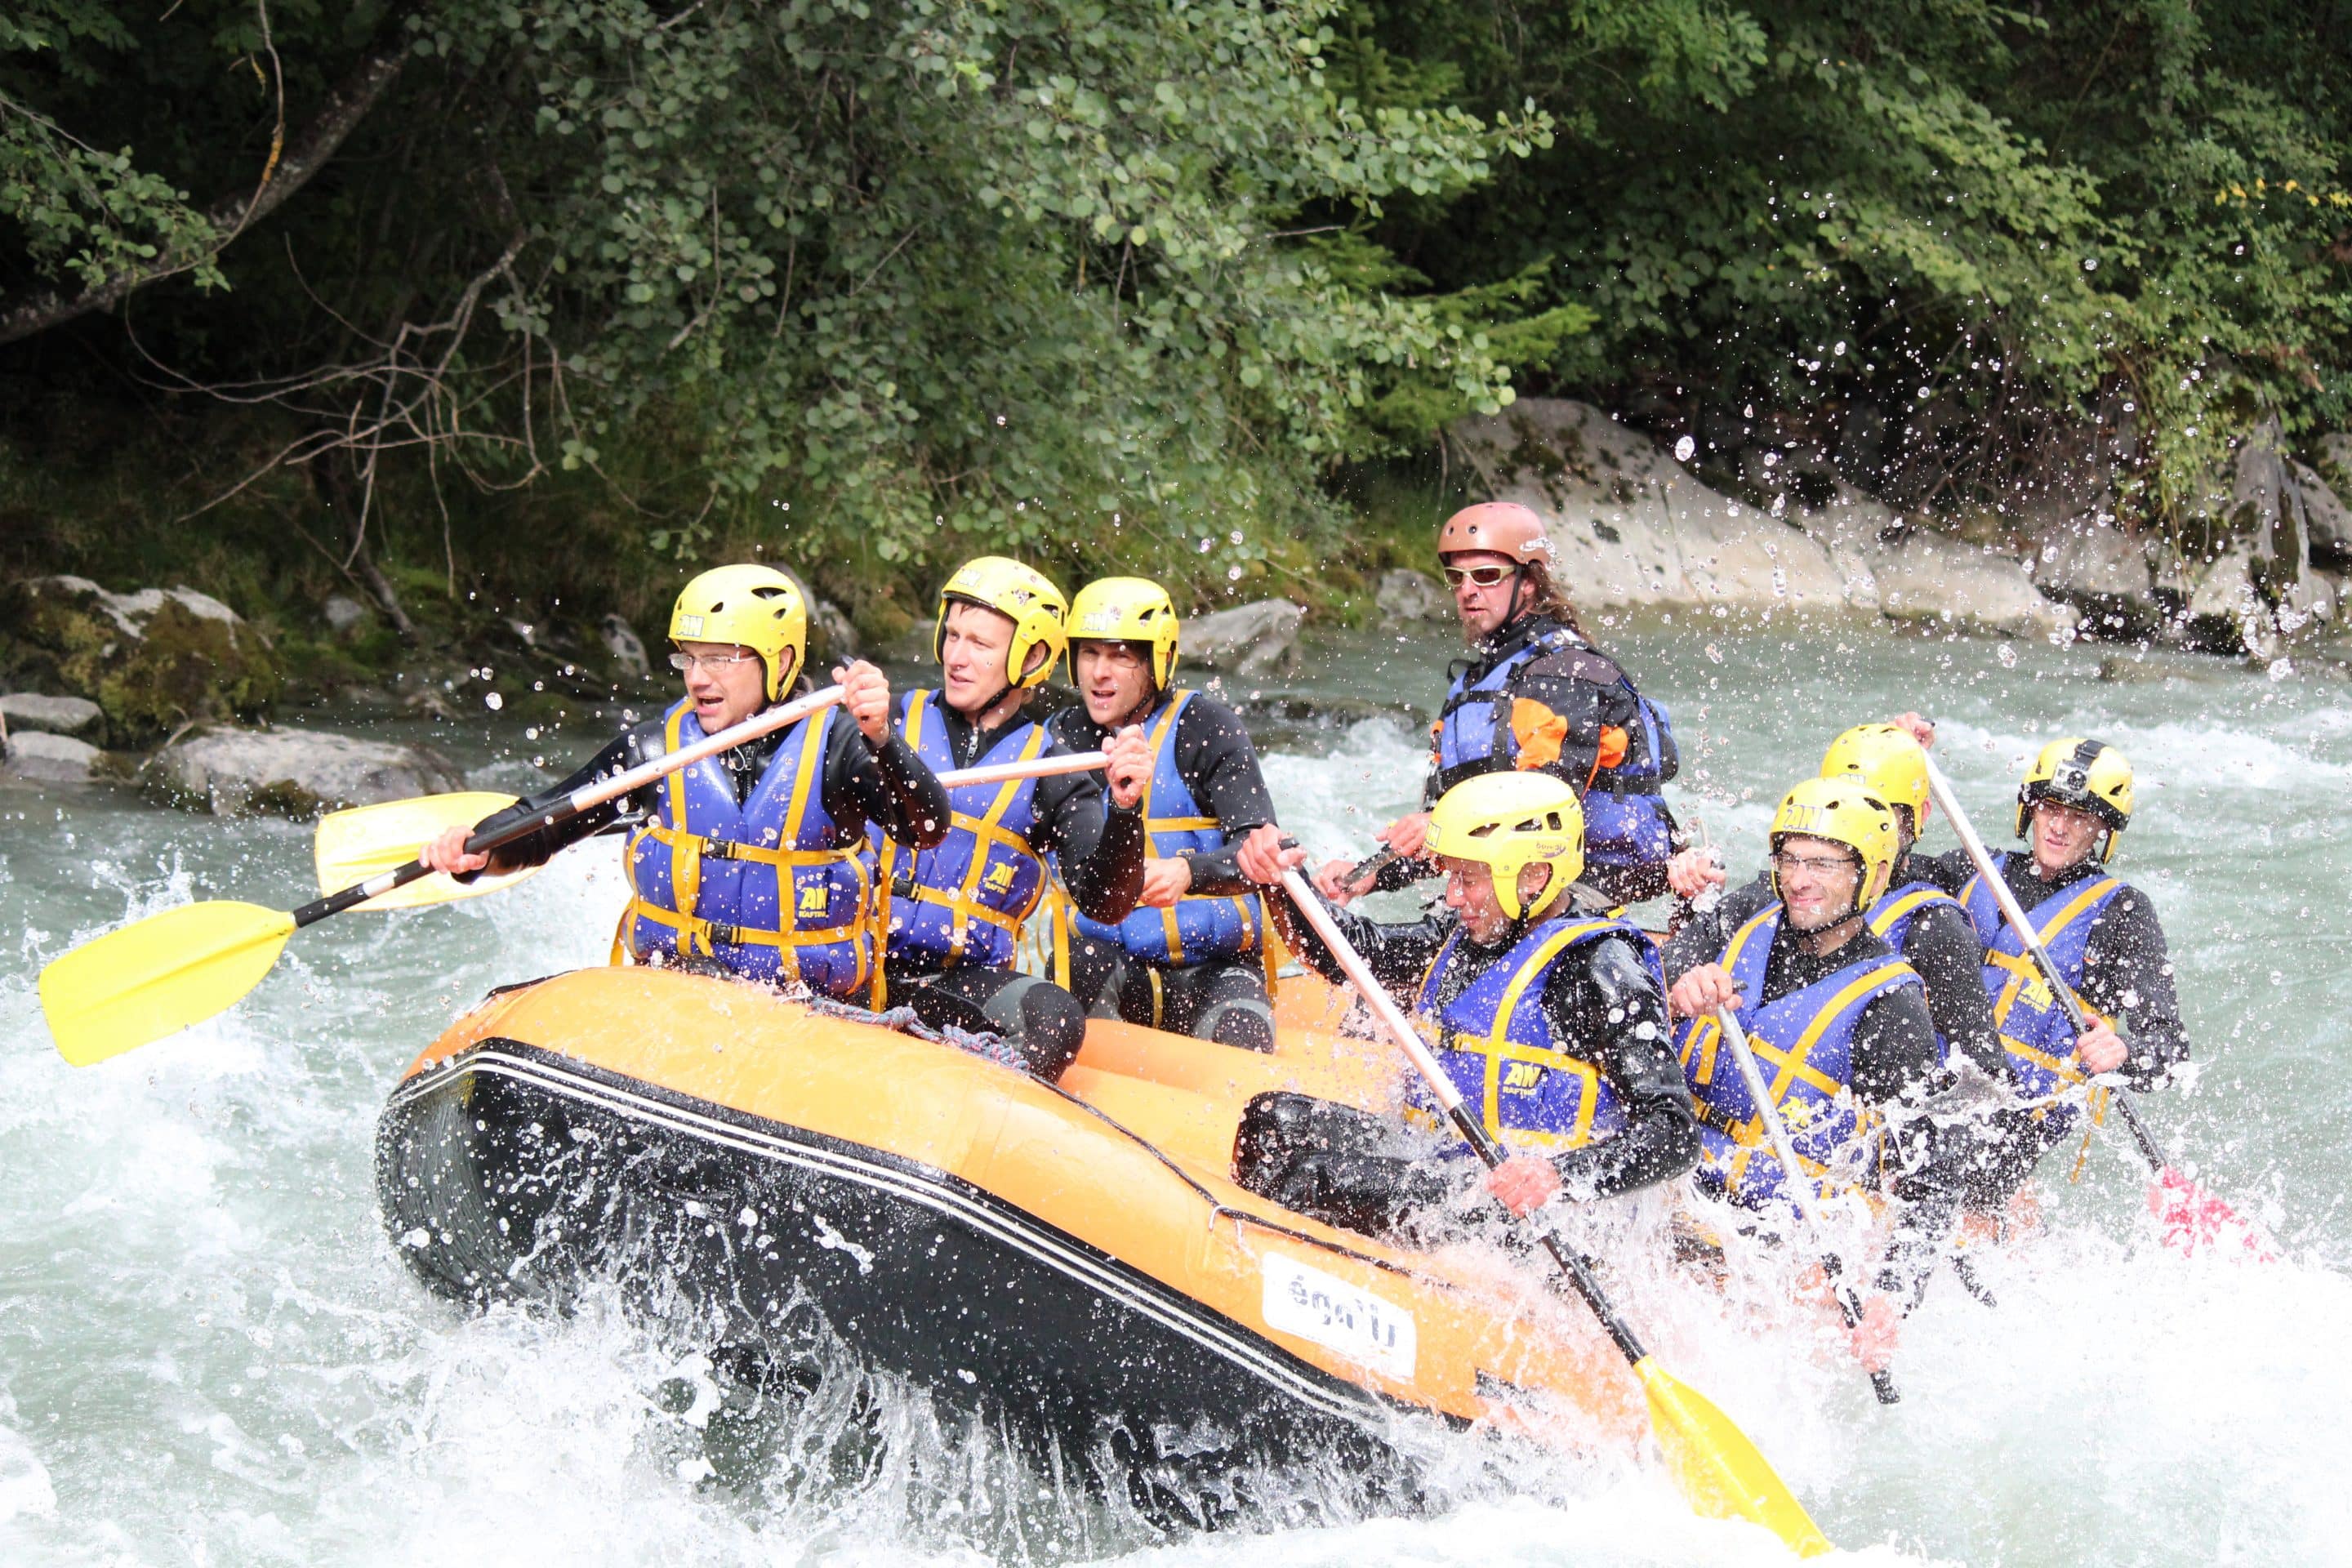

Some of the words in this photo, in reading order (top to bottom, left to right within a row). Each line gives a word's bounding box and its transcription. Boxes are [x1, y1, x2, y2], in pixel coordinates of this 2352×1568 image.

[677, 613, 705, 637] AN
[1080, 612, 1108, 631] AN
[1784, 804, 1824, 831] AN
[799, 887, 828, 910] AN
[2020, 979, 2054, 1009] AN
[1503, 1062, 1542, 1087] AN
